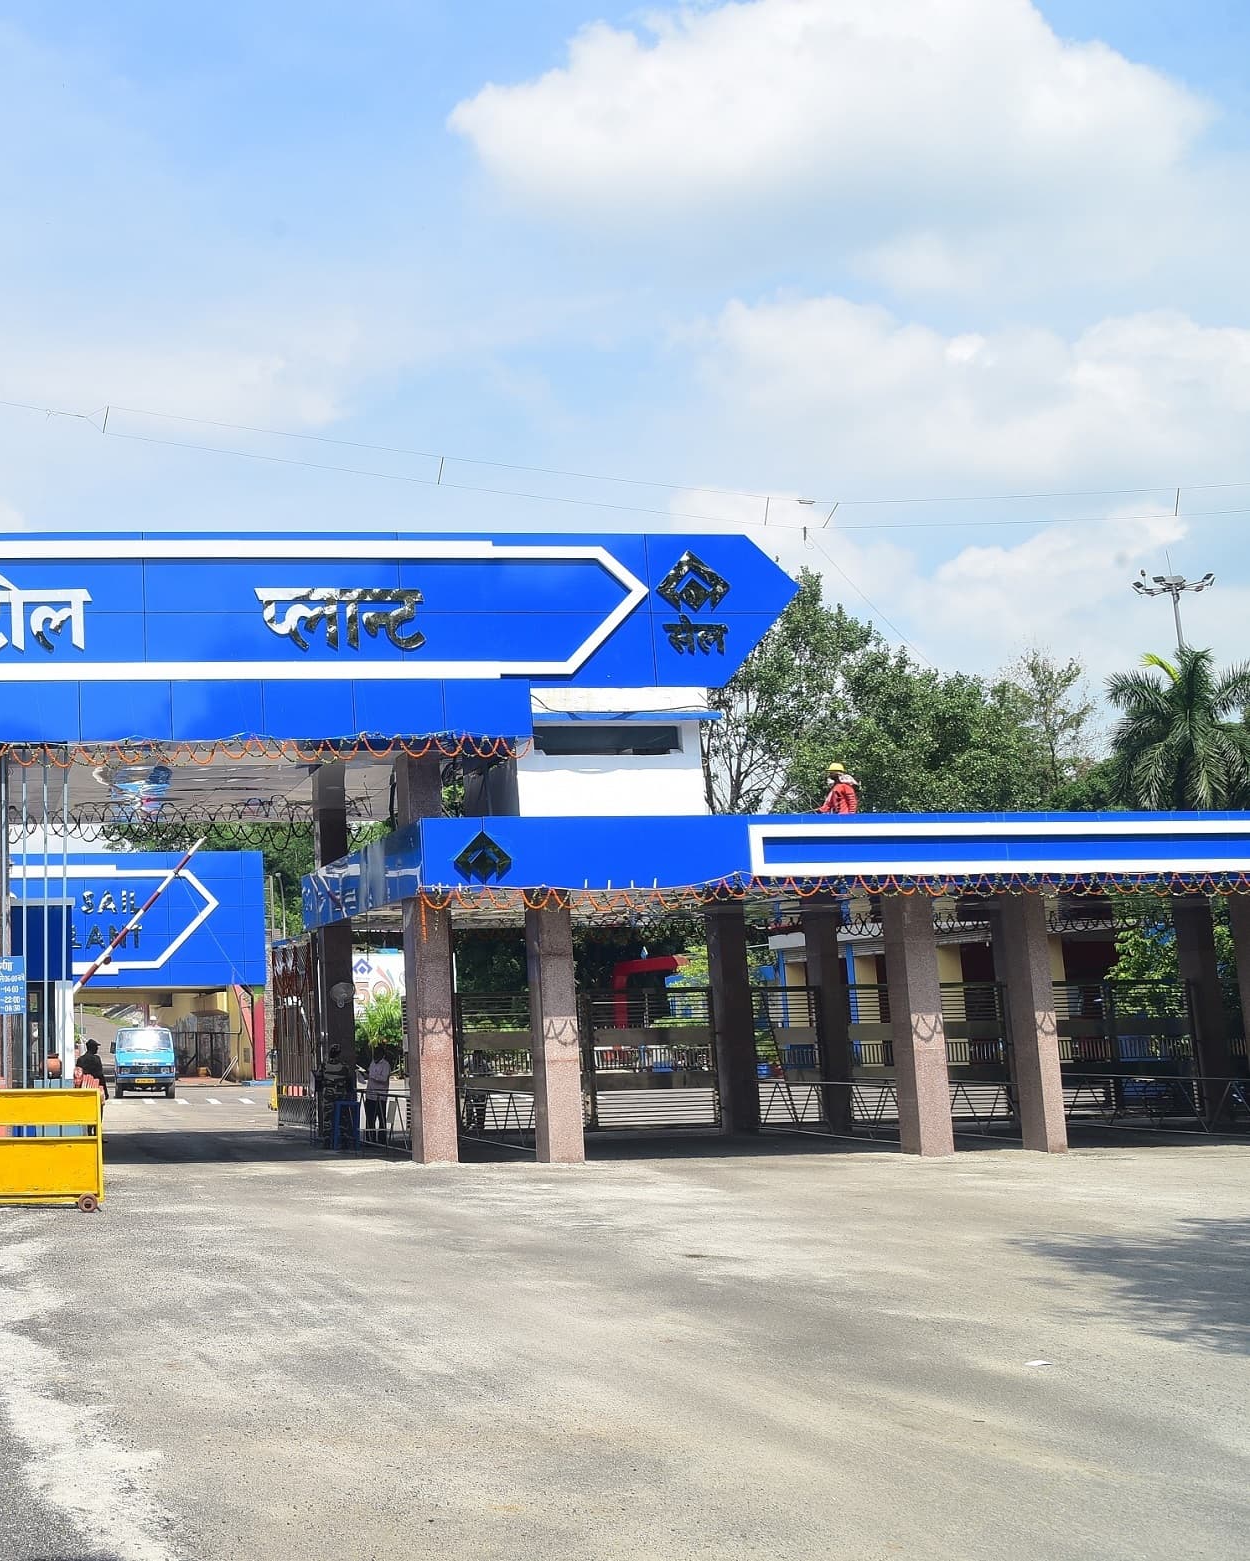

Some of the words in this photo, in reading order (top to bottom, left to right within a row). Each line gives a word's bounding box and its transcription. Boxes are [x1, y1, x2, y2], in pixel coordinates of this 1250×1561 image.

[253, 587, 427, 651] प्लान्ट
[662, 613, 729, 656] सेल
[80, 889, 142, 915] SAIL
[71, 923, 143, 949] LANT
